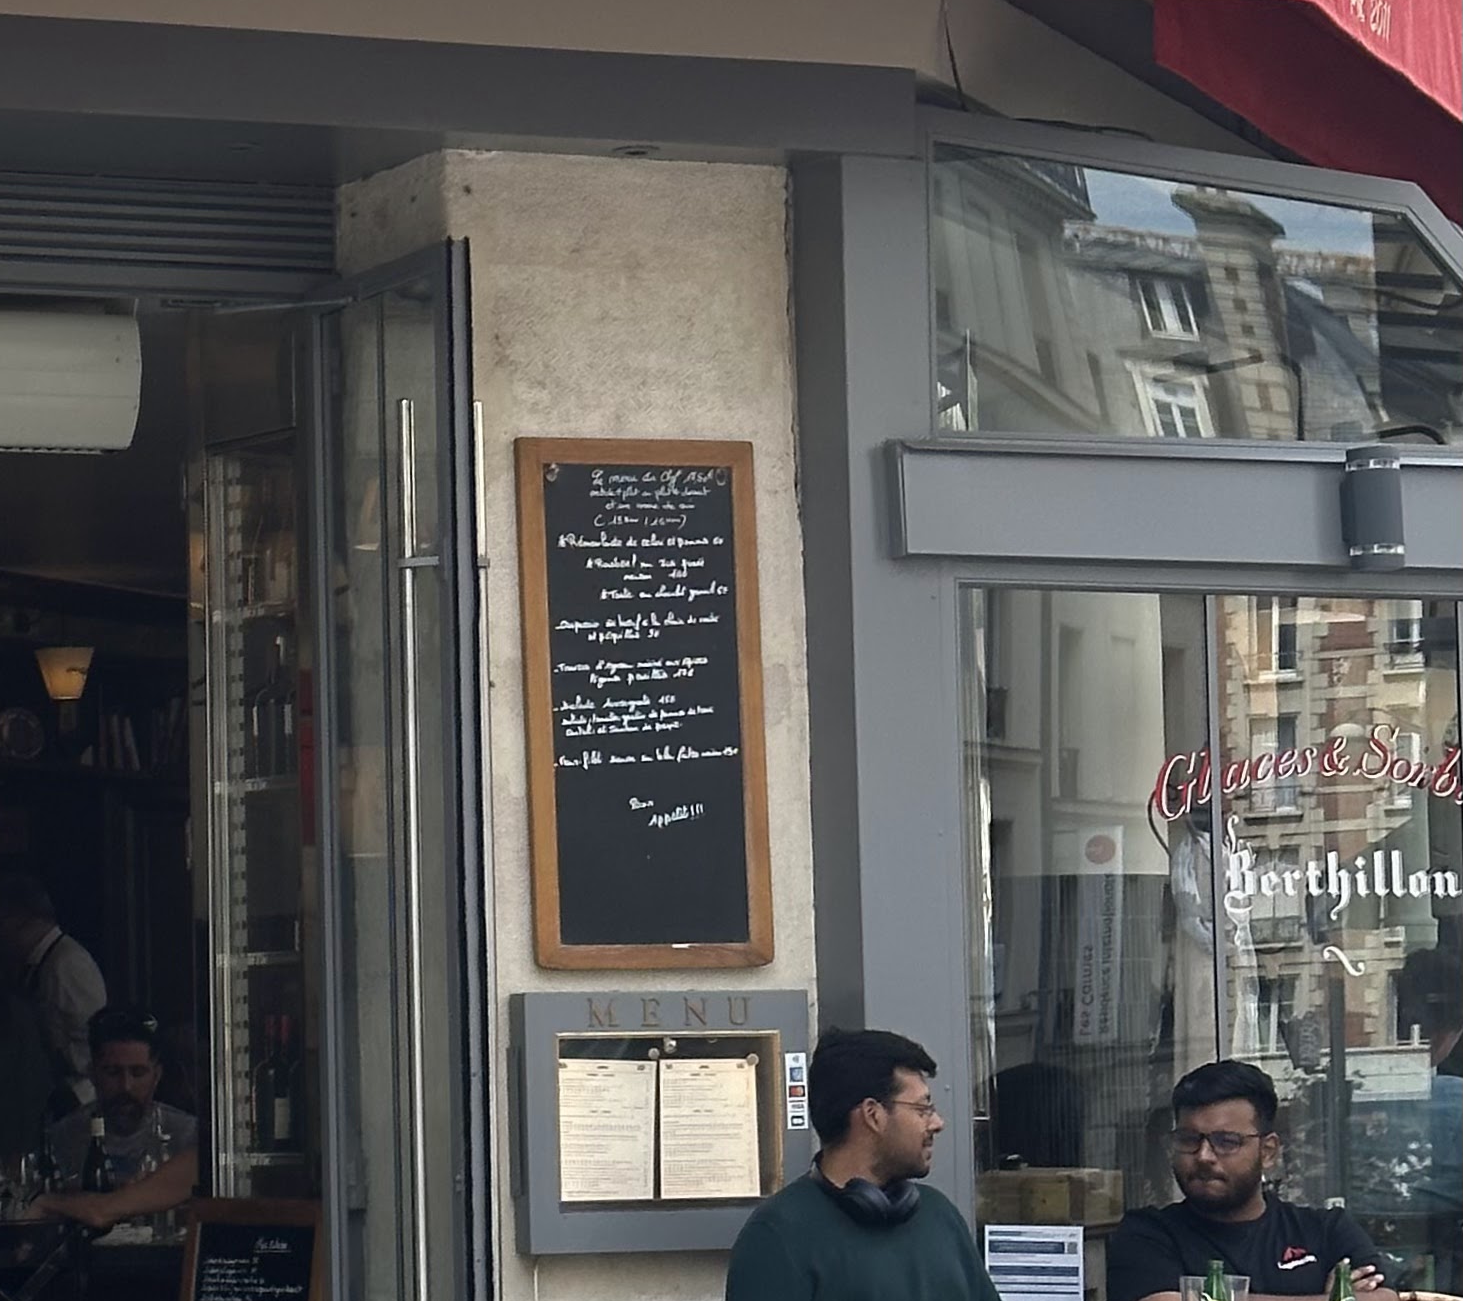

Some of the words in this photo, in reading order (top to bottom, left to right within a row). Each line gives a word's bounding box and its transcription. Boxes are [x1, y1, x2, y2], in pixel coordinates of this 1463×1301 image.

[1155, 747, 1318, 822] Glaces
[1320, 735, 1350, 777] &
[1222, 814, 1463, 922] Berthillon
[587, 997, 751, 1028] MENU
